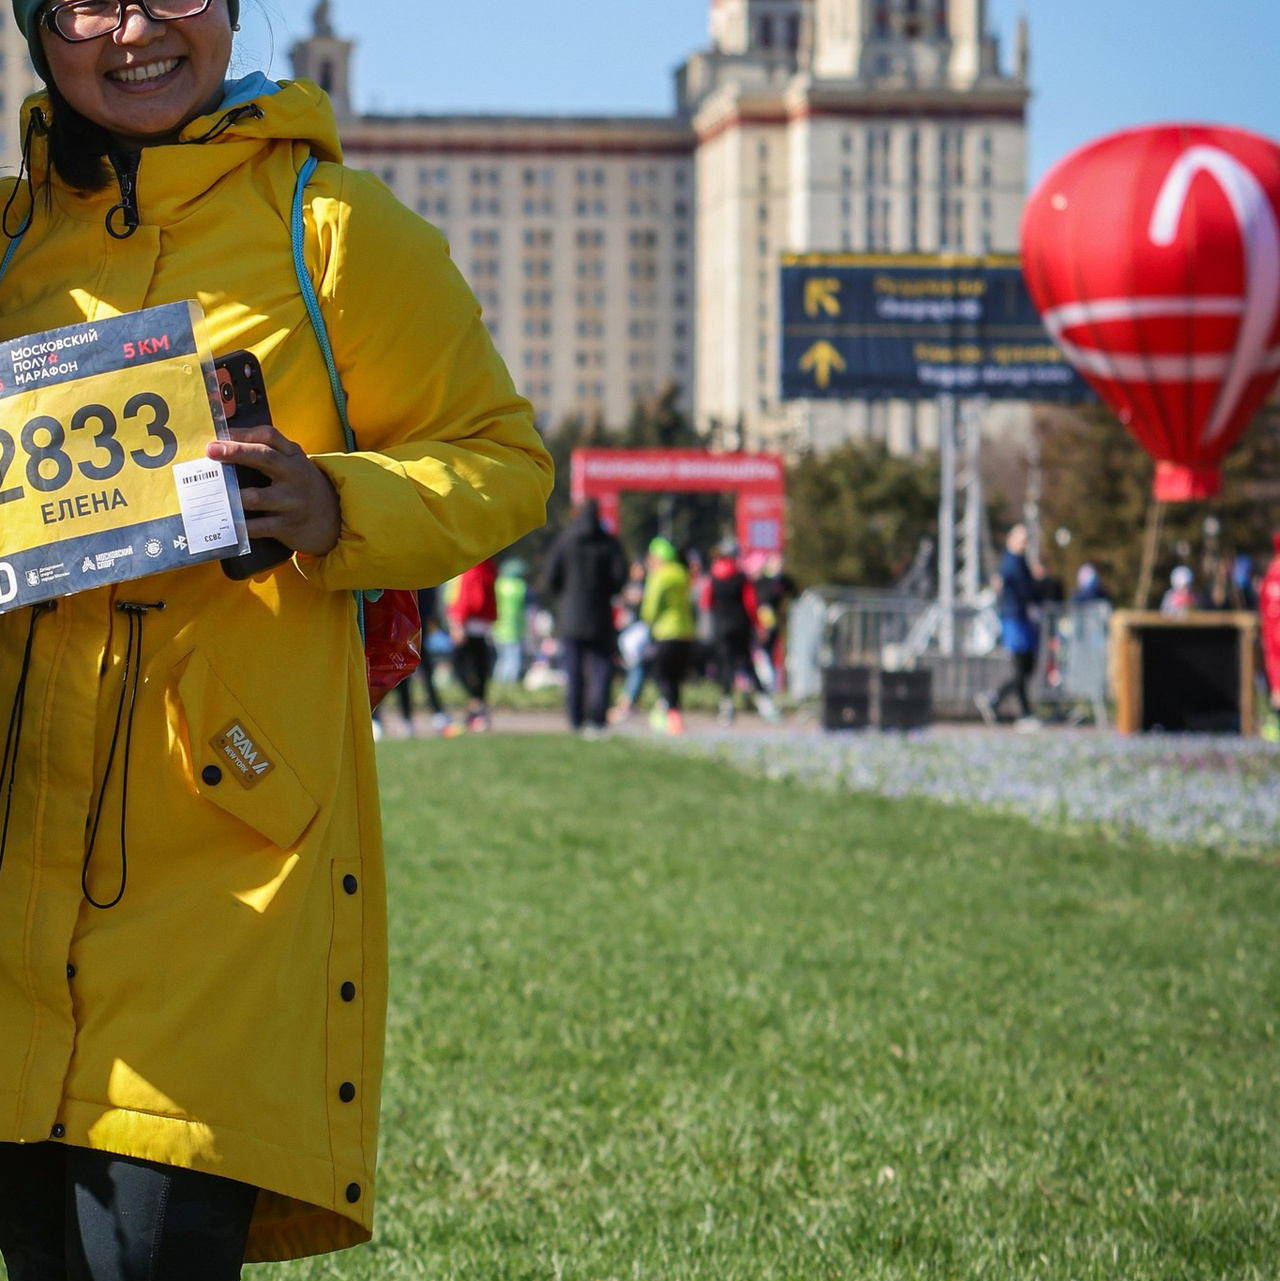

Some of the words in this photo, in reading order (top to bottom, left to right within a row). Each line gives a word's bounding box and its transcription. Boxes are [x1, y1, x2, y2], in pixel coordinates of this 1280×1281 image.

[10, 328, 99, 362] МОСКОВСКИЙ
[13, 355, 48, 374] ПОЛУ
[15, 360, 79, 386] МАРАФОН
[40, 487, 129, 525] ЕЛЕНА
[204, 532, 222, 543] 2833
[224, 745, 237, 760] NEW
[234, 756, 249, 774] YORK
